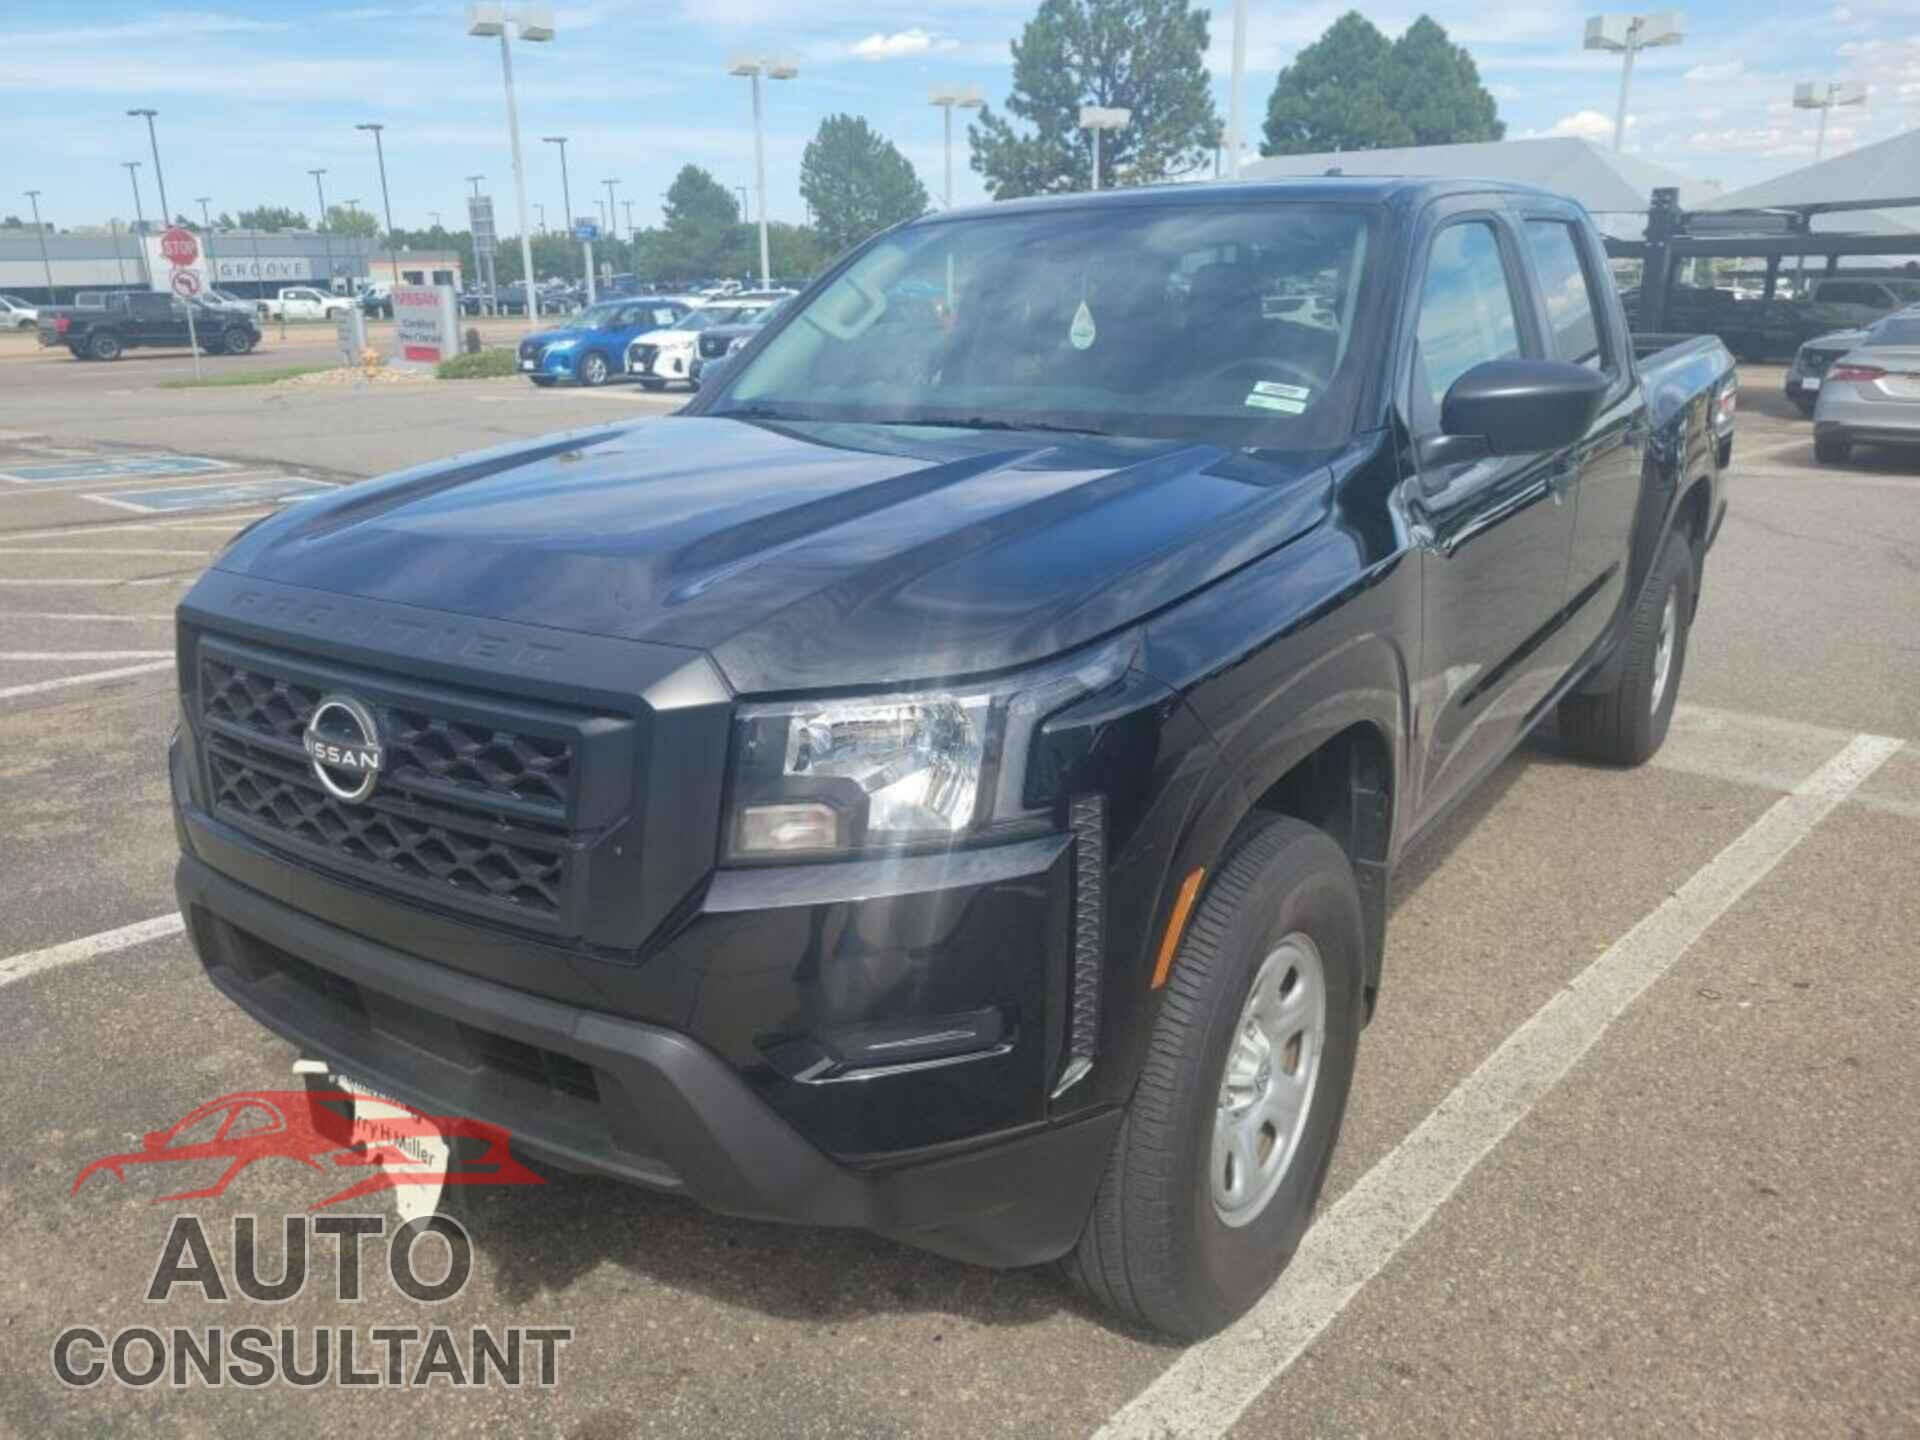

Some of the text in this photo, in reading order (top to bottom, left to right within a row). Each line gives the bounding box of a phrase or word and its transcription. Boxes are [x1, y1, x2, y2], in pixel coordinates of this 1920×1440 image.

[164, 240, 194, 255] STOP
[220, 262, 305, 277] GROOVE
[303, 735, 379, 769] NISSAN
